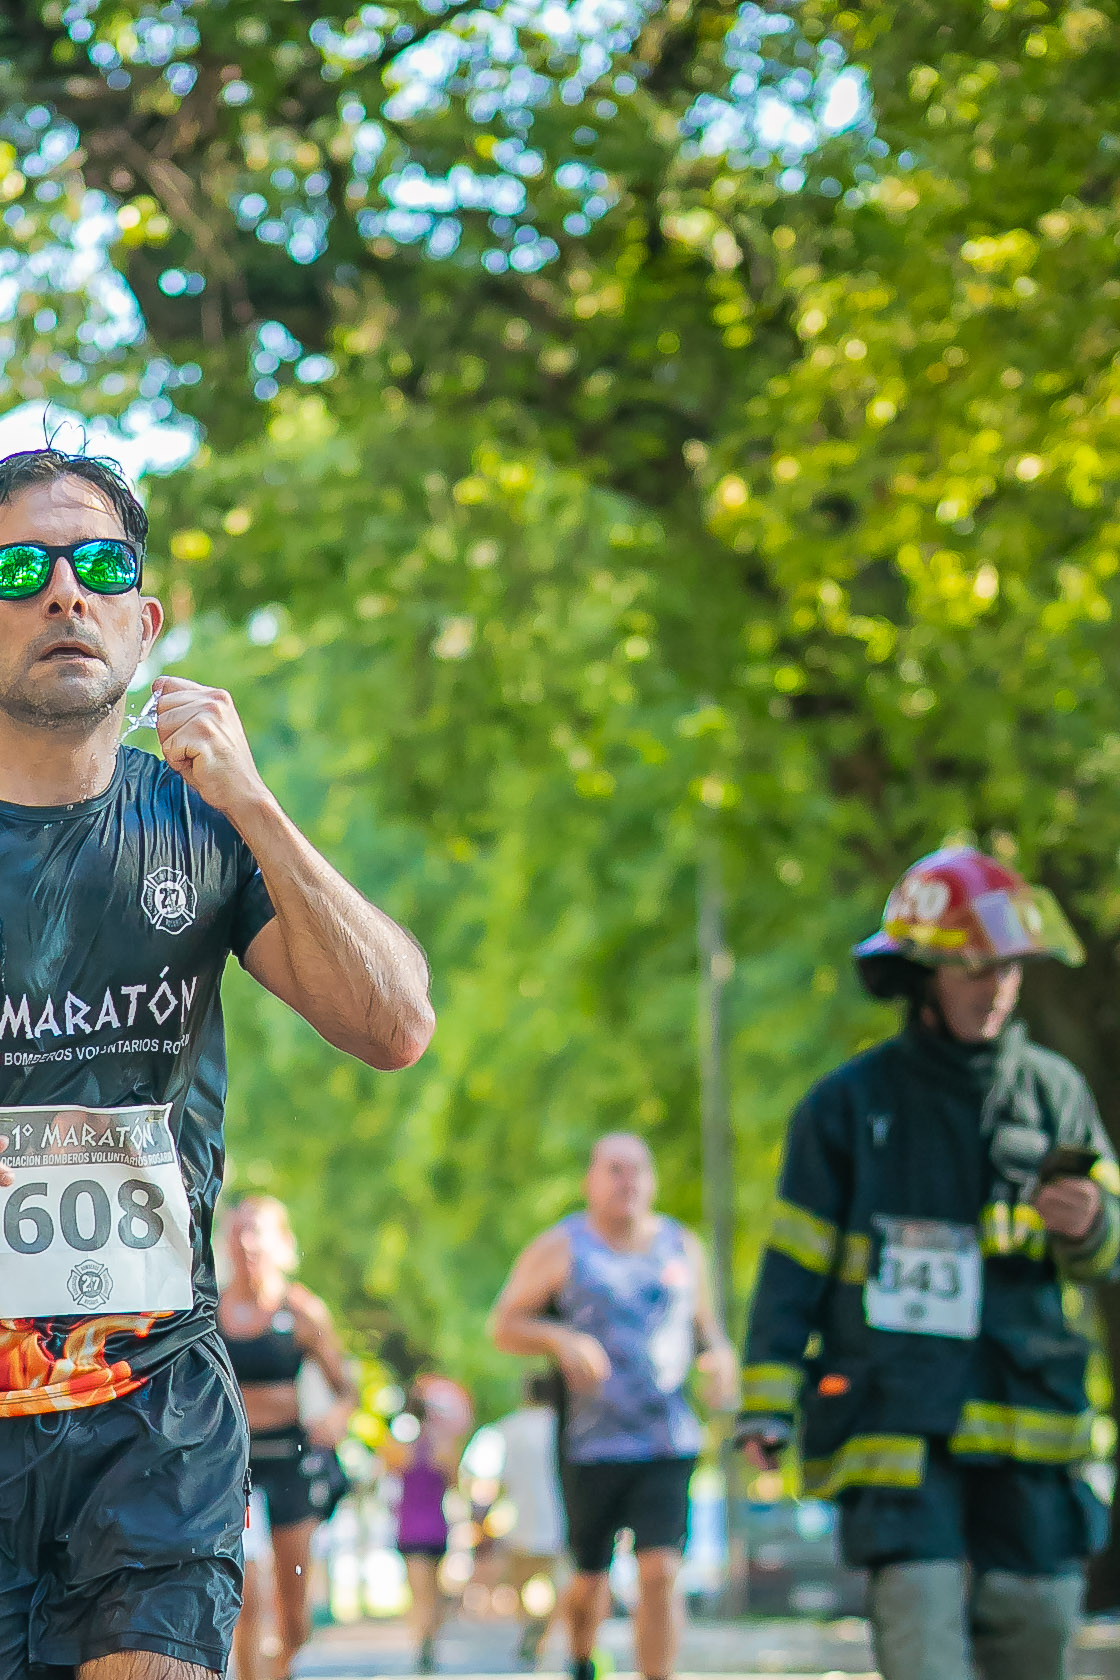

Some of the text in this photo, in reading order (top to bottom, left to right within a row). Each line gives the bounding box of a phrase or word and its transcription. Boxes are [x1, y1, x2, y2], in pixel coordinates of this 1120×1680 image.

[40, 1117, 156, 1151] MARATÓN
[42, 1152, 90, 1166] BOMBEROS
[90, 1151, 148, 1167] VOLUNTARIOS
[3, 1178, 165, 1255] 608
